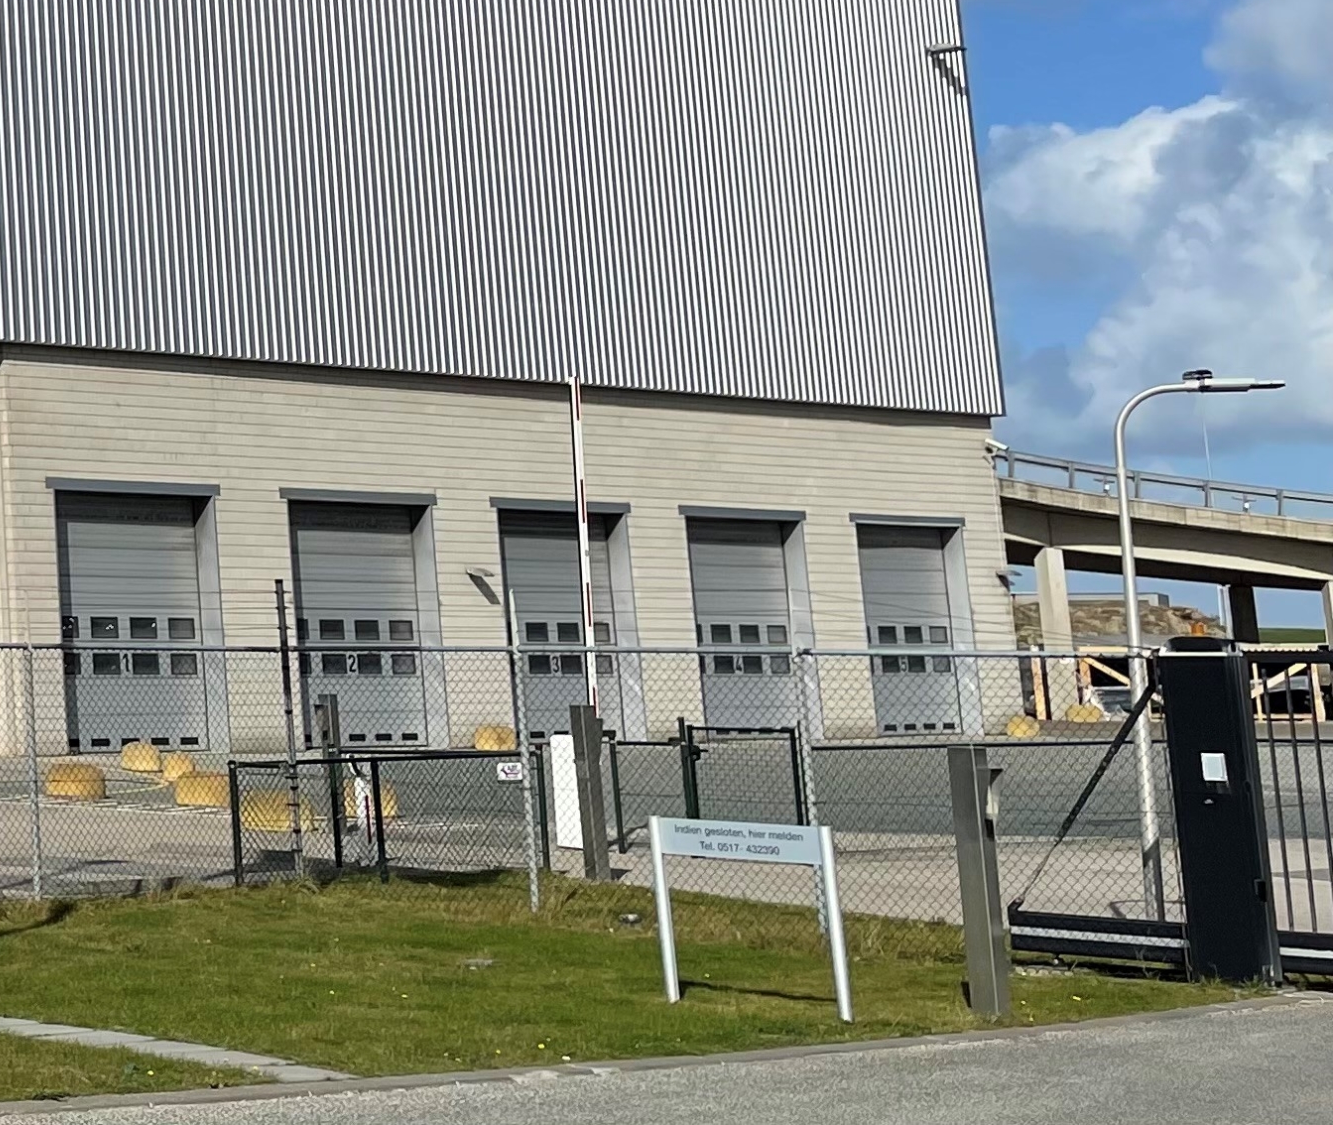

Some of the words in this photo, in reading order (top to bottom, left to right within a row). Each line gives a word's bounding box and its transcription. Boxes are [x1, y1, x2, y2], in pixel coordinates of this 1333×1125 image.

[123, 653, 129, 672] 1
[348, 655, 356, 673] 2
[552, 656, 560, 673] 3
[735, 656, 743, 672] 4
[900, 656, 907, 673] 5
[674, 824, 702, 835] Indien
[748, 829, 766, 839] hier
[768, 831, 804, 841] melden
[699, 840, 715, 850] Tel.
